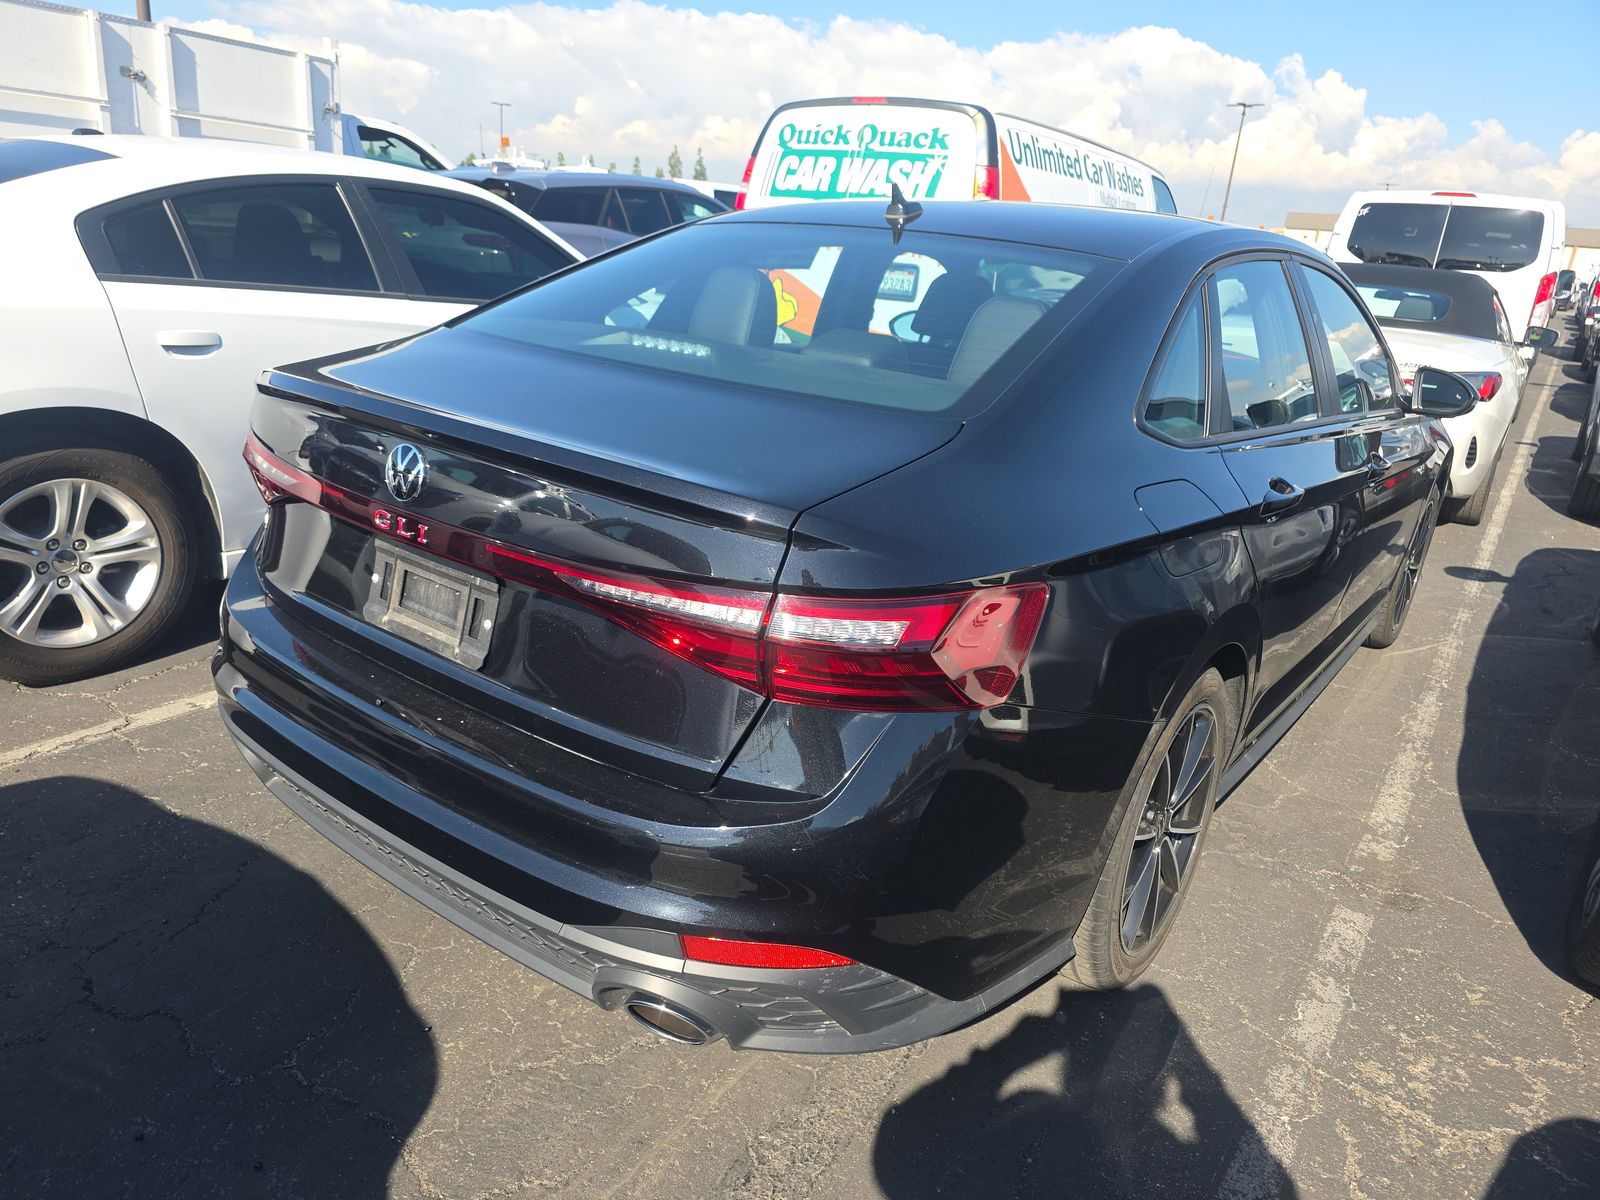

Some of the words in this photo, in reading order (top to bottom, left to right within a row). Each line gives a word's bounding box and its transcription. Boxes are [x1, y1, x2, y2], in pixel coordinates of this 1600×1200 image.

[777, 123, 852, 150] Quick
[857, 123, 950, 151] Quack
[774, 154, 838, 192] CAR
[836, 156, 938, 198] WASH
[1006, 128, 1083, 181] Unlimited
[1083, 153, 1104, 186] Car
[1103, 159, 1144, 197] Washes
[374, 509, 429, 544] GLI
